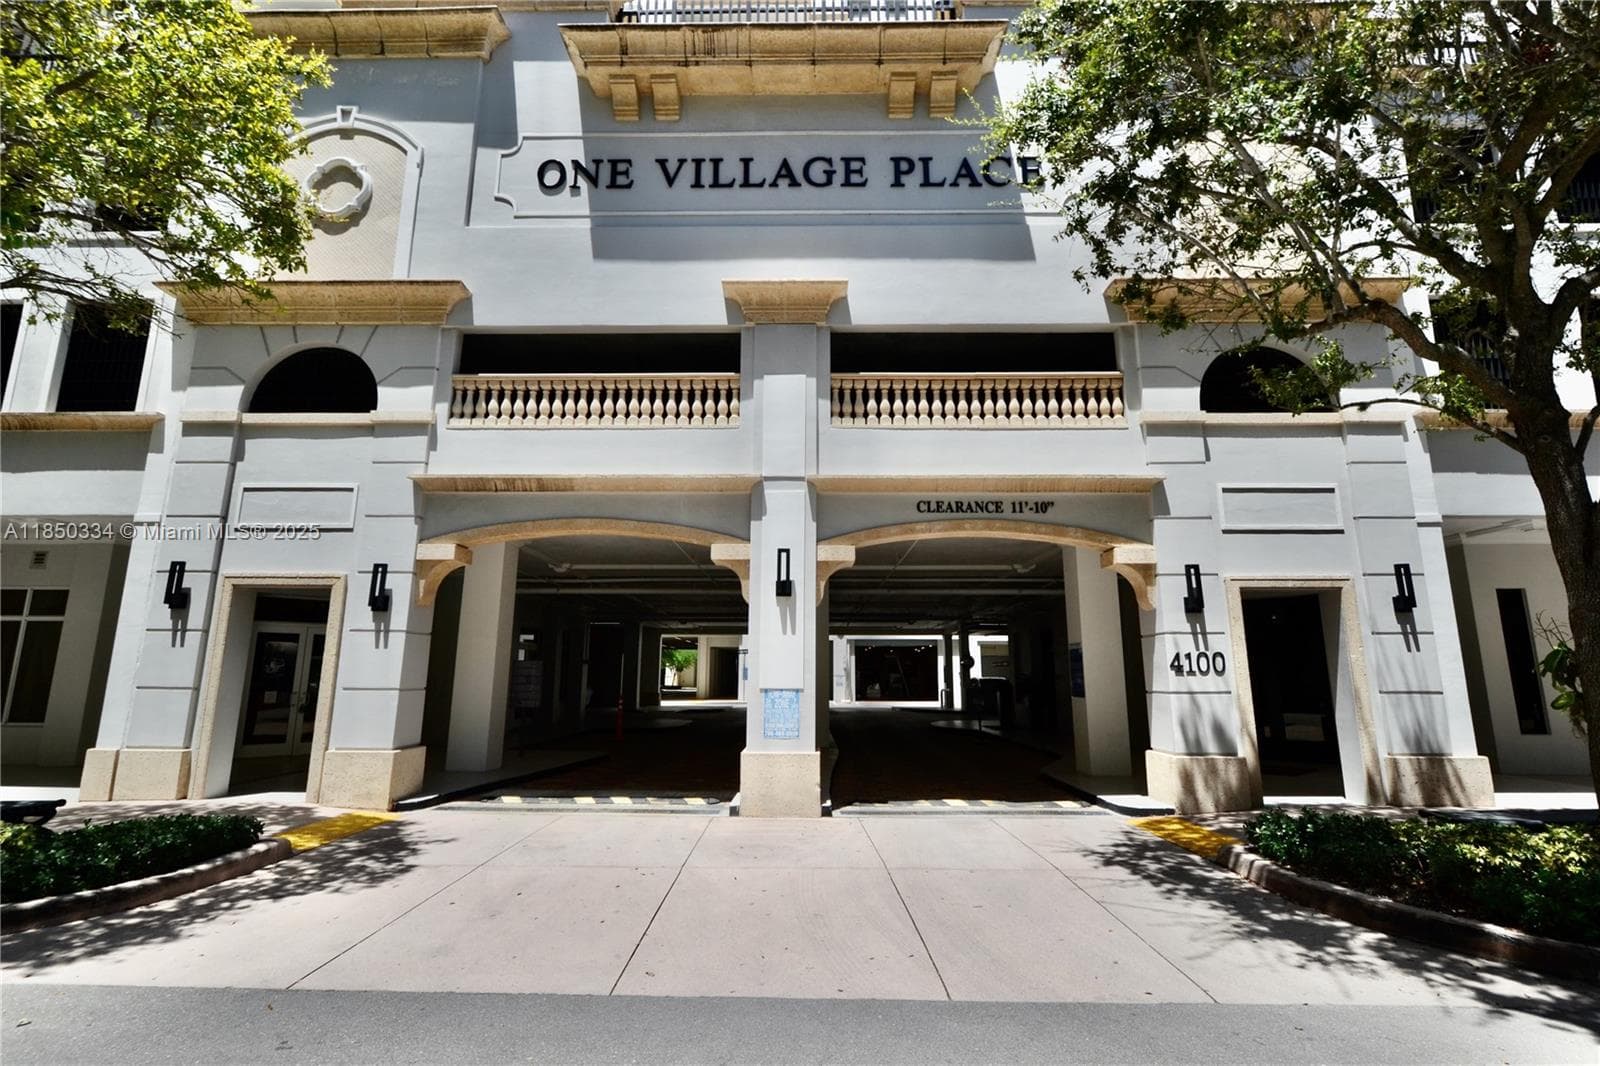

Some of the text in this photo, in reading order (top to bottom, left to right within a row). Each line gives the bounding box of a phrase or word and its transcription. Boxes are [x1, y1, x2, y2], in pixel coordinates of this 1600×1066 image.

[537, 156, 1045, 190] ONE VILLAGE PLACE
[916, 500, 1004, 513] CLEARANCE
[1169, 651, 1226, 675] 4100
